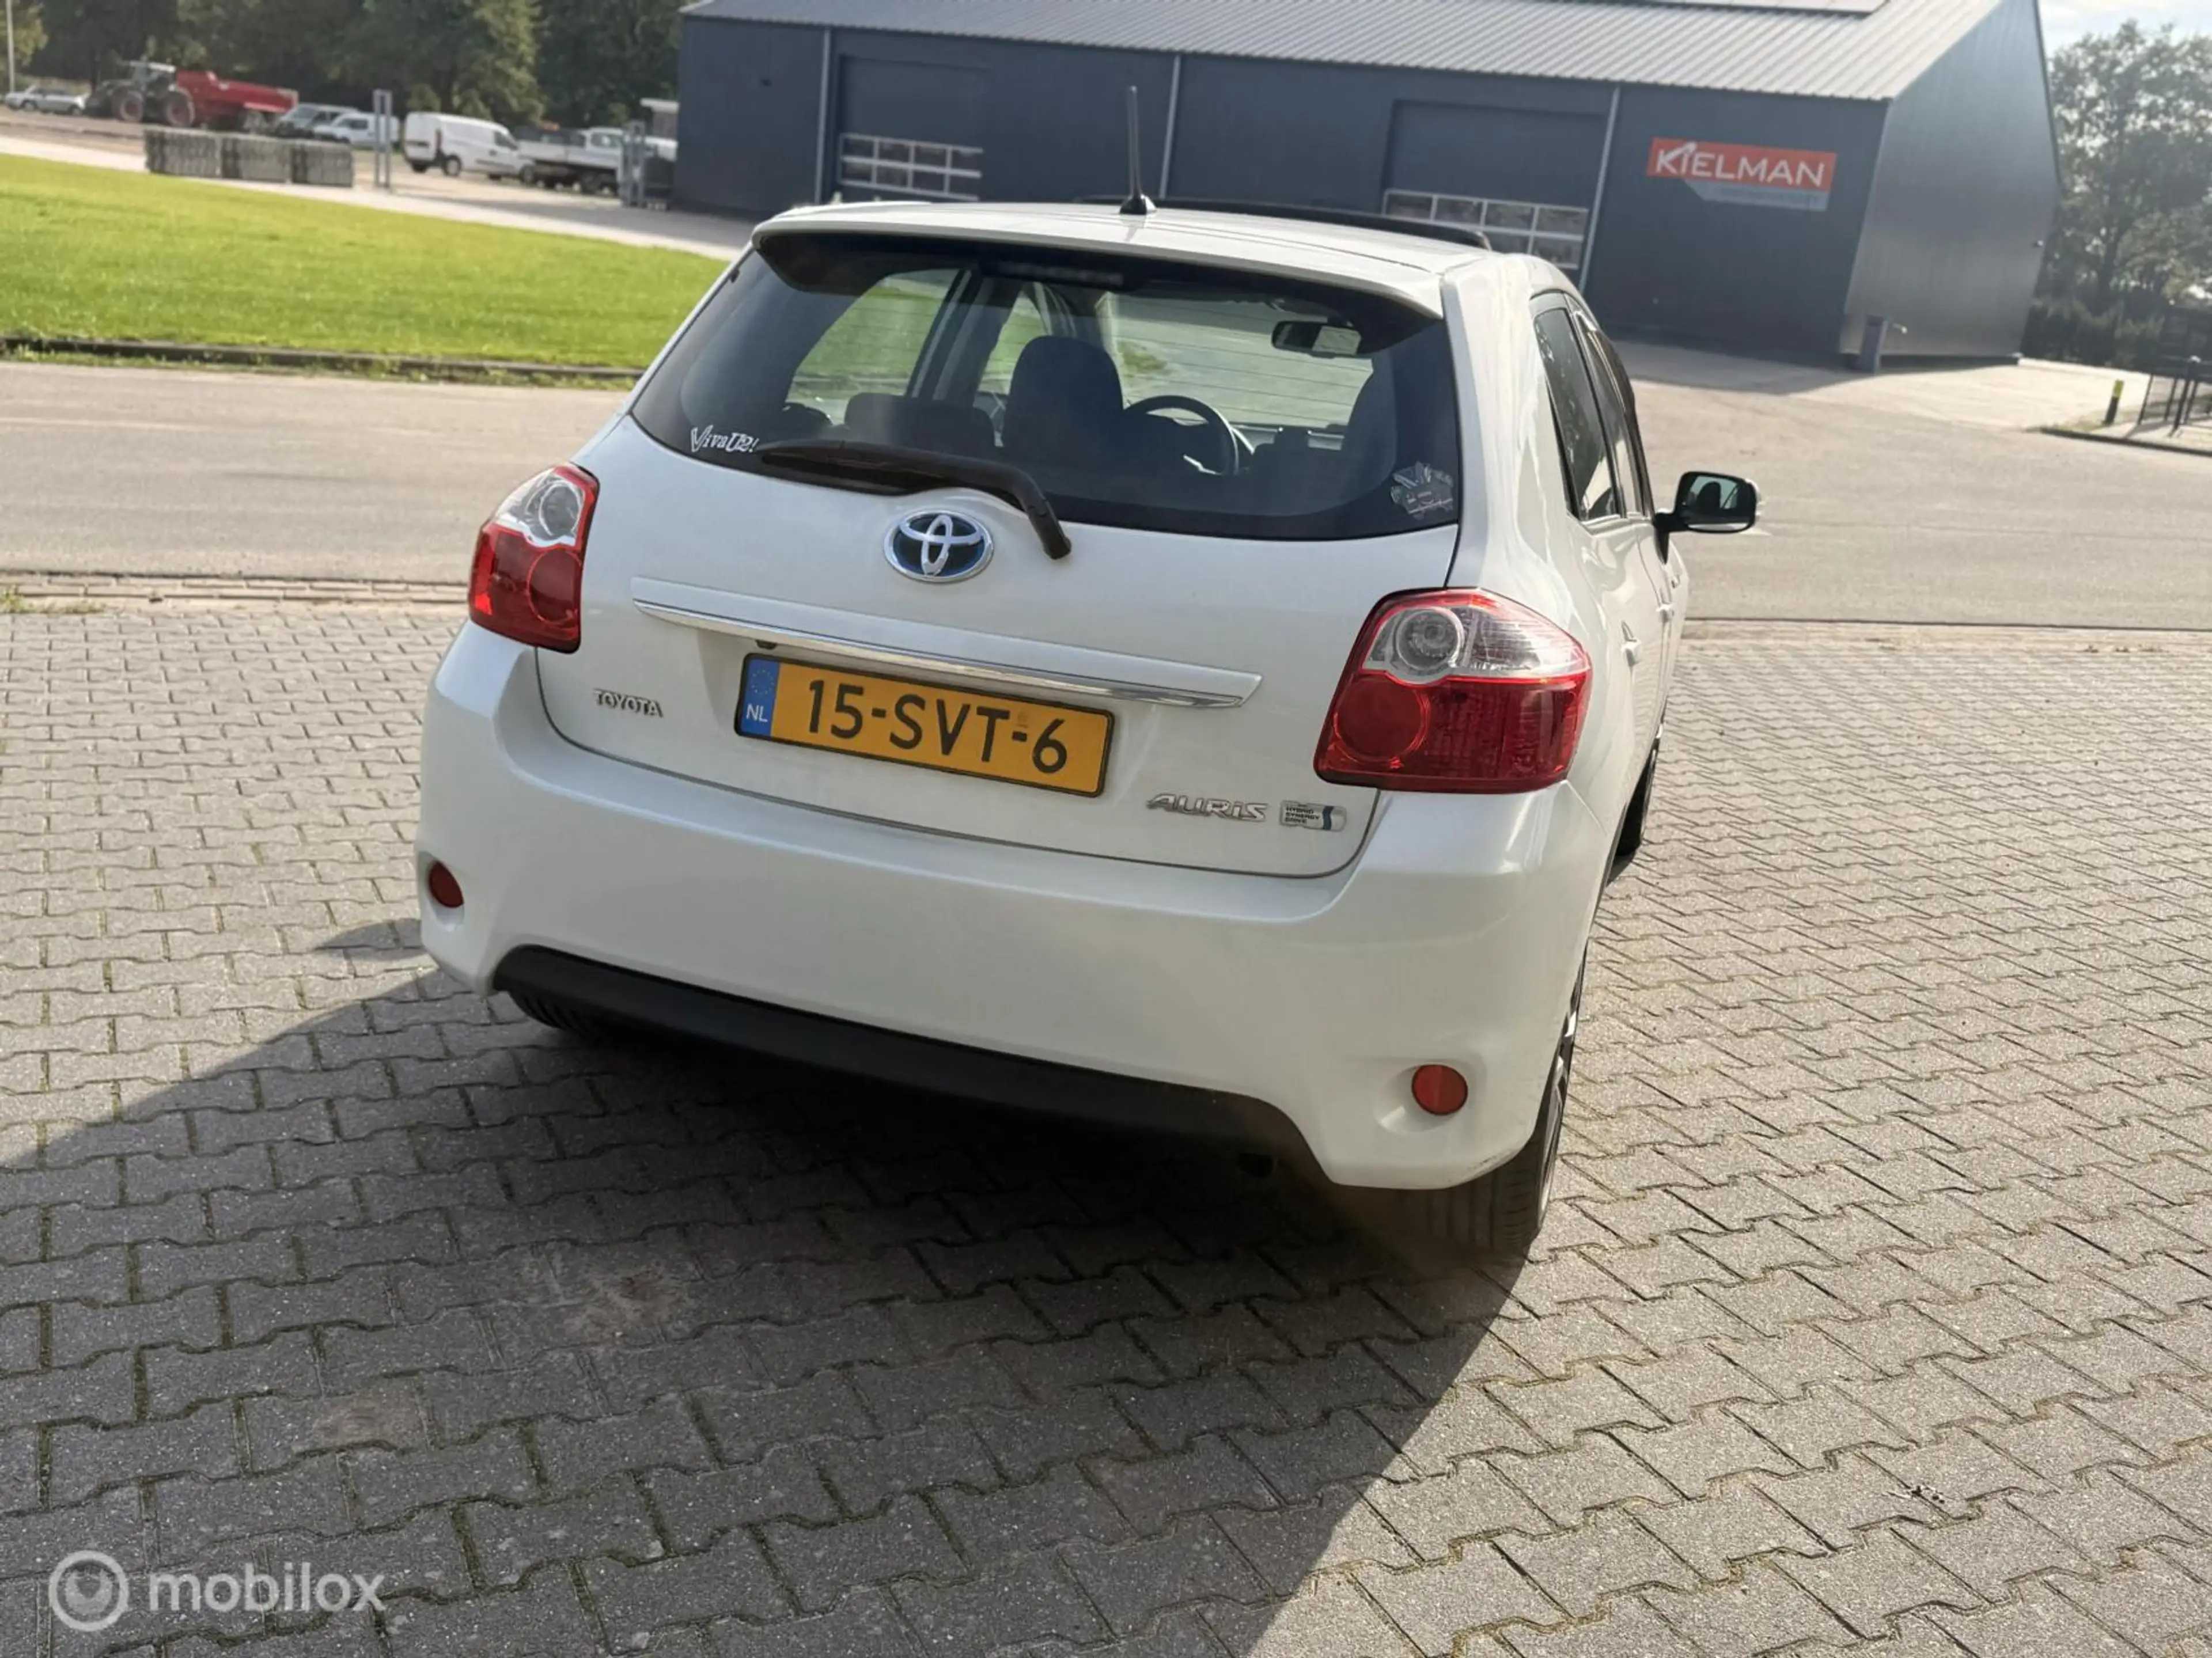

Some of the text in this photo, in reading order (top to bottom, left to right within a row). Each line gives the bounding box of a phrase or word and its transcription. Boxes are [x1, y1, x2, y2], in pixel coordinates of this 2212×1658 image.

[1656, 141, 1825, 187] KIELMAN
[593, 687, 663, 718] TOYOTA
[746, 703, 768, 722] NL
[808, 680, 1067, 774] 15-SVT-6
[1146, 793, 1268, 822] AURIS
